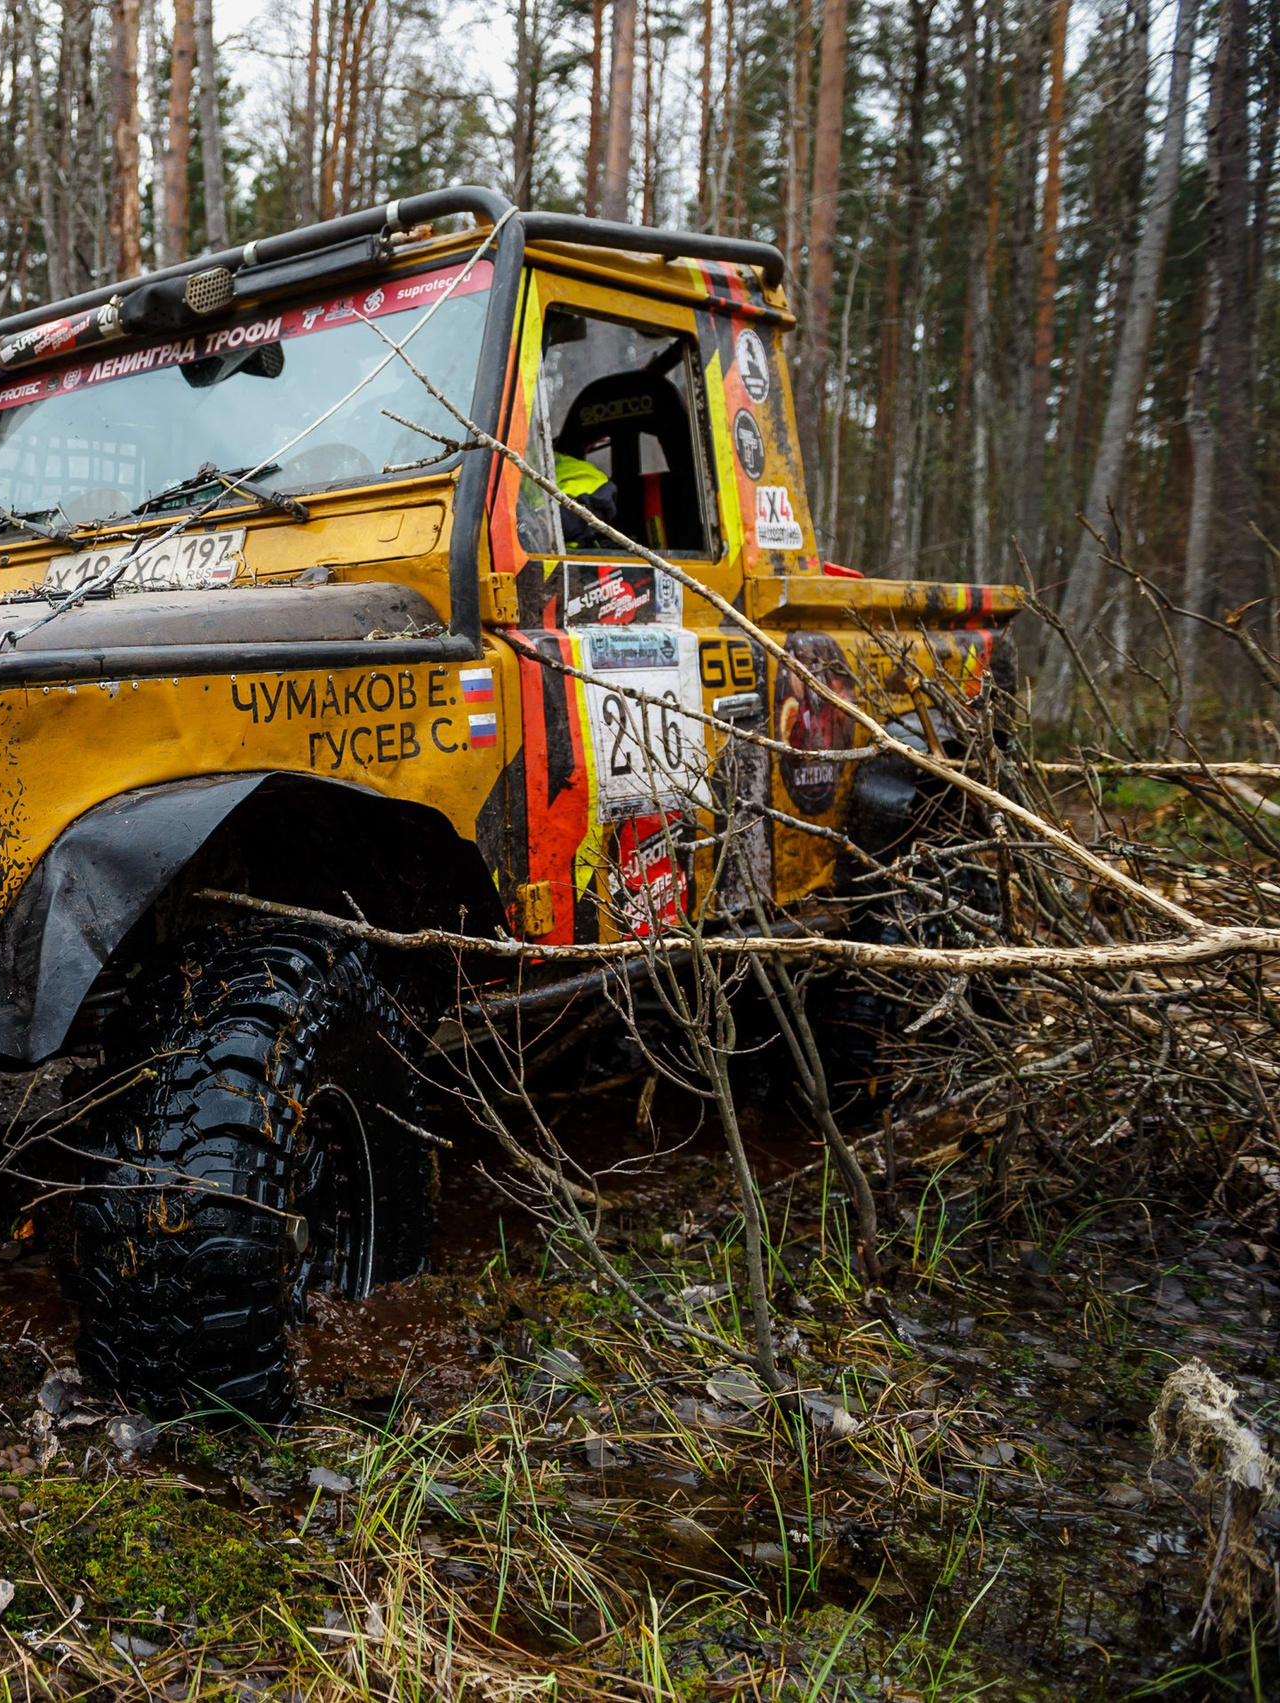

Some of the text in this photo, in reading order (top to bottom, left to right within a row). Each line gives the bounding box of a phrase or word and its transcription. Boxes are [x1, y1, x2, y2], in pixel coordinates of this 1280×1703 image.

[87, 317, 282, 382] ЛЕНИНГРАД ТРОФИ
[580, 395, 654, 425] sparco
[183, 535, 234, 569] 197
[186, 567, 212, 580] RUS
[232, 672, 417, 723] ЧУМАКОВ
[309, 722, 421, 770] ГУСЕВ
